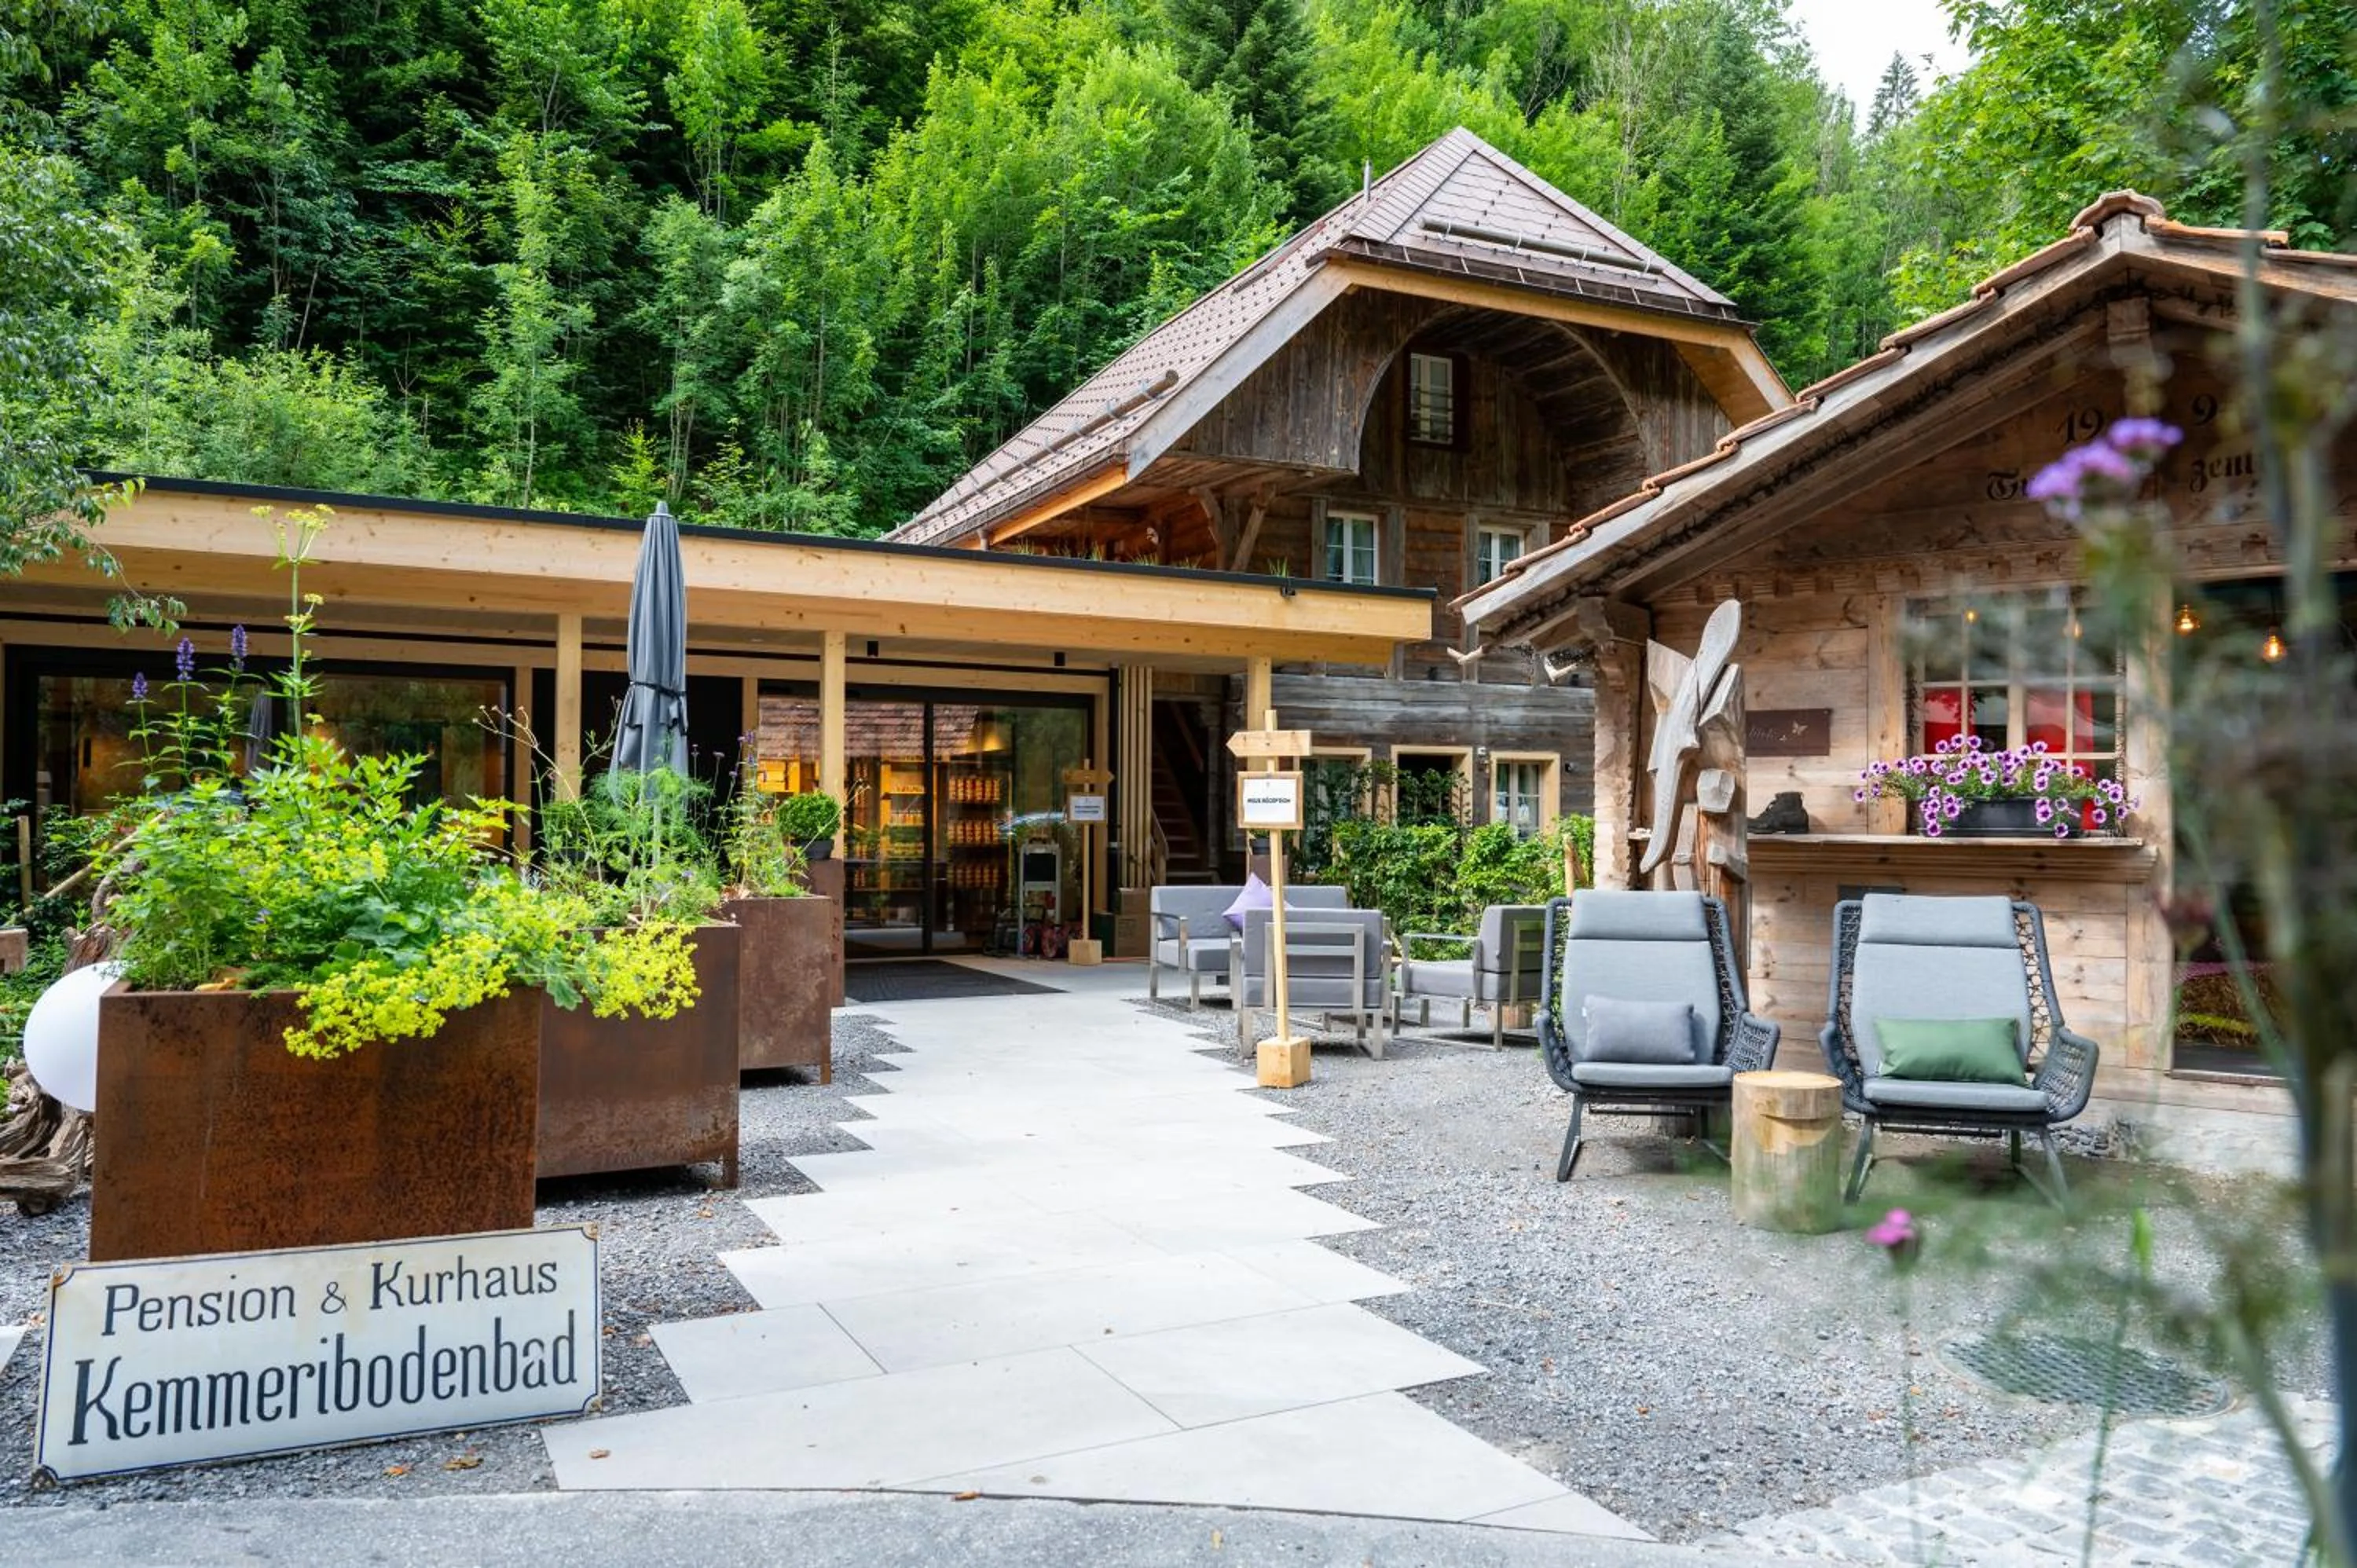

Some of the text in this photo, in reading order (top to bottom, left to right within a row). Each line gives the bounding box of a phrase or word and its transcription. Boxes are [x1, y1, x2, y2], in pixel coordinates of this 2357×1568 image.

[101, 1255, 558, 1336] Pension & Kurhaus
[68, 1310, 577, 1446] Kemmeribodenbad
